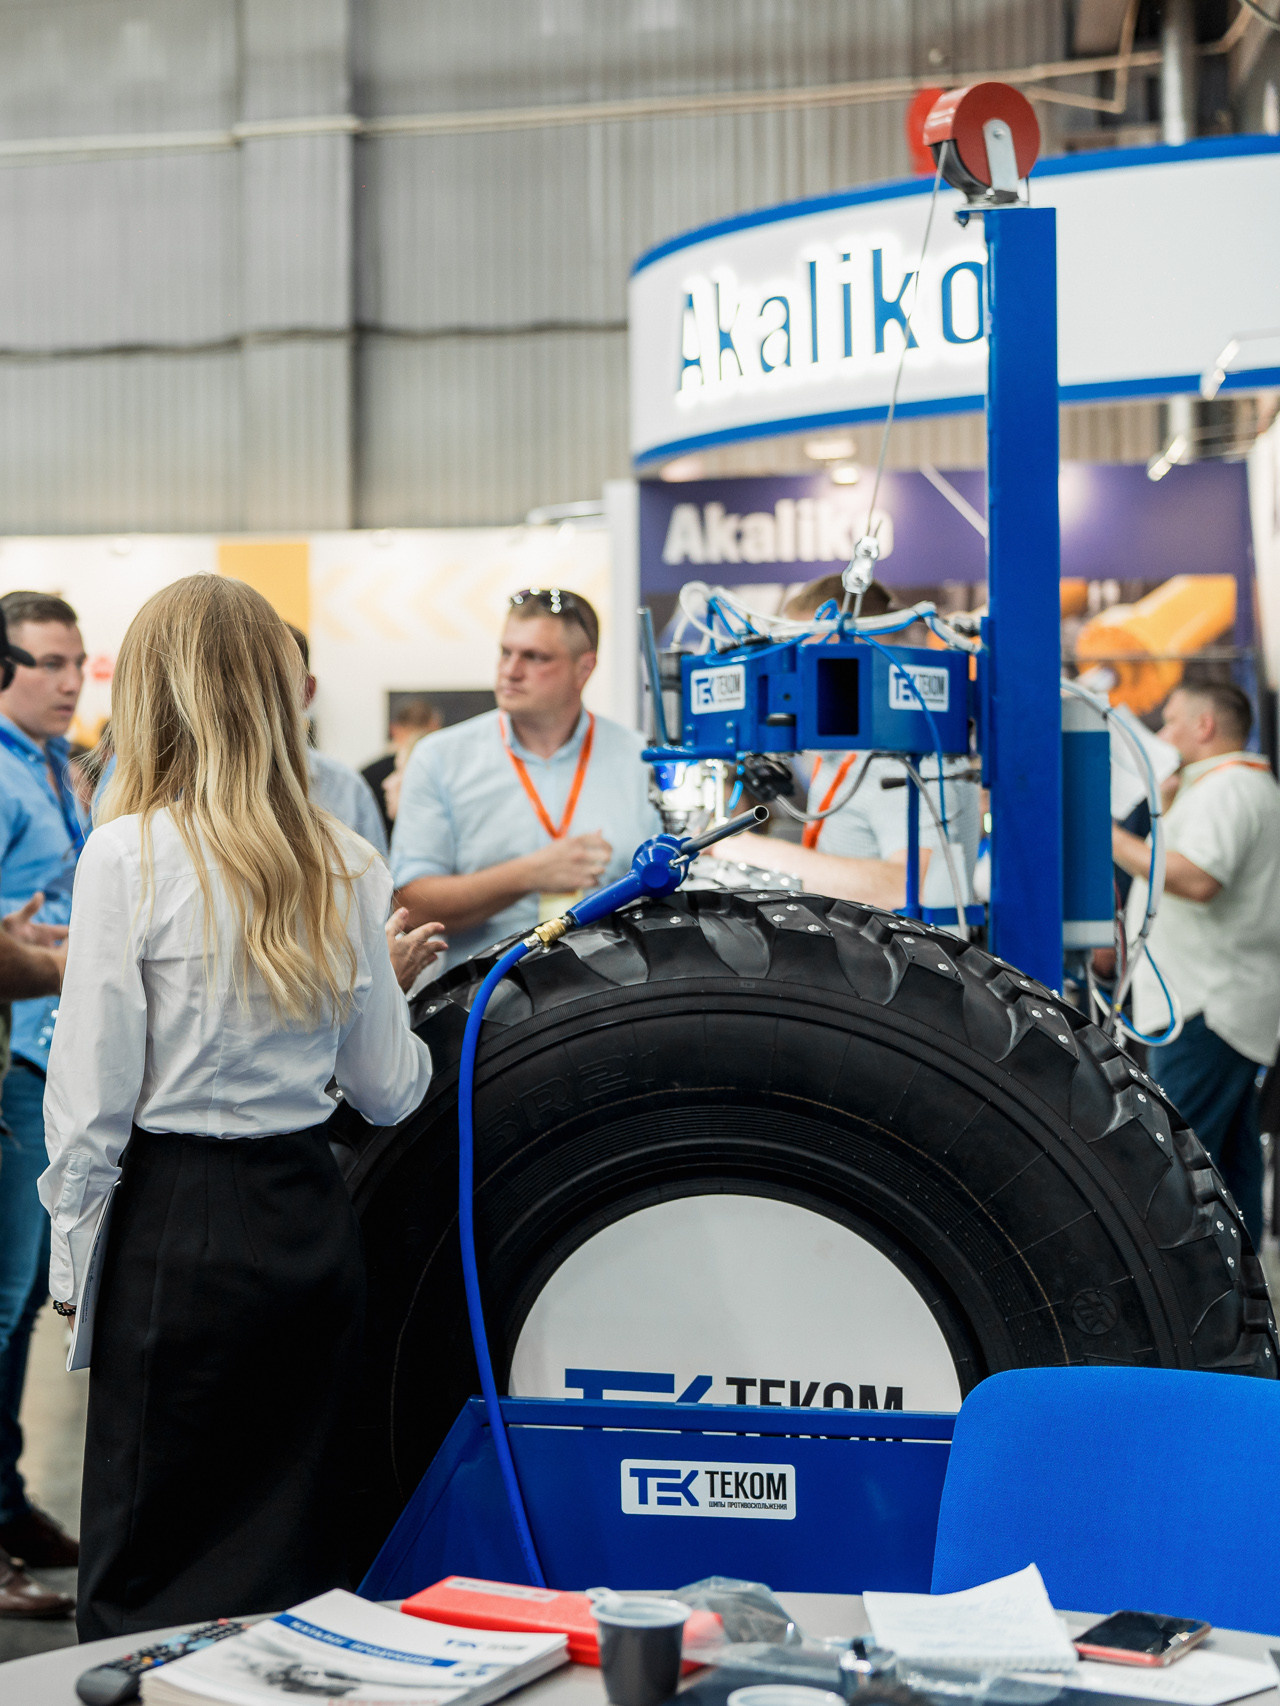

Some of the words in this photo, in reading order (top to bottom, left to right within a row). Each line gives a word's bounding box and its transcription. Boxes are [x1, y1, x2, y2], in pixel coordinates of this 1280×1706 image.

[679, 248, 984, 392] Akaliko
[662, 498, 894, 565] Akaliko
[705, 1471, 787, 1500] ТЕКОМ
[727, 1502, 788, 1511] ПРОТИВОСКОЛЬЖЕНИЯ
